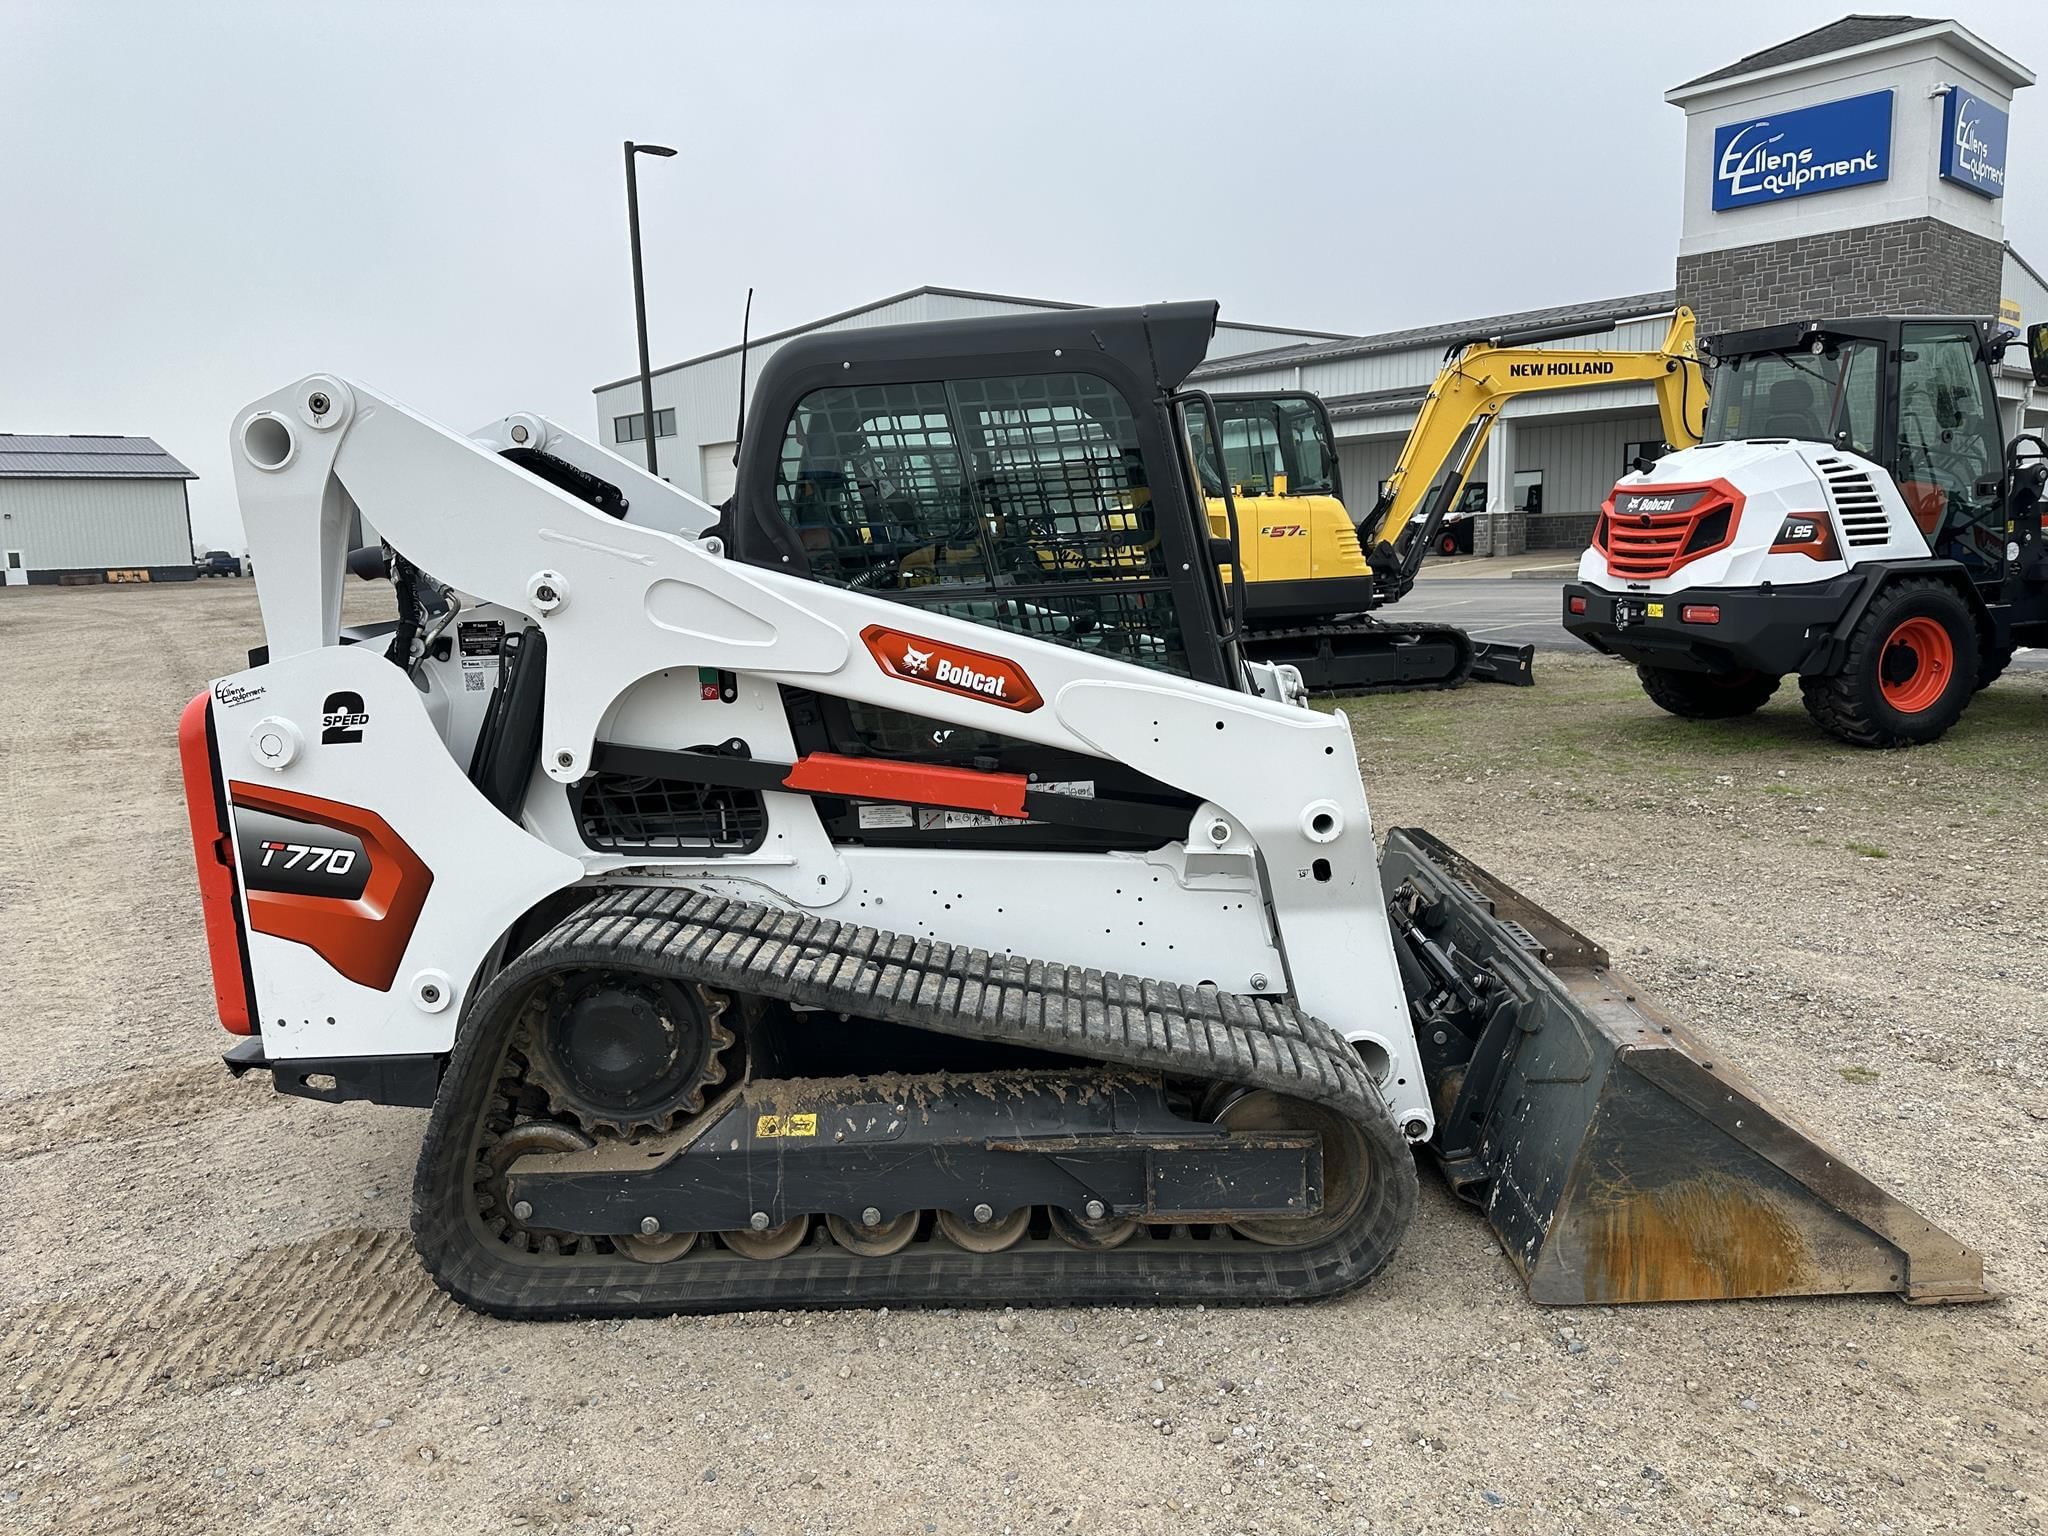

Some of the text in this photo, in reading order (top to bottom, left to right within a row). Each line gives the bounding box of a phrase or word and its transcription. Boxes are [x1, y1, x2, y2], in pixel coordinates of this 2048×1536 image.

[1719, 122, 1813, 180] Ellens
[1957, 99, 1988, 158] Ellens
[1731, 134, 1878, 195] Equipment
[1960, 120, 2004, 186] Equipment
[1510, 362, 1613, 376] NEW HOLLAND
[1639, 498, 1675, 511] Bobcat
[936, 659, 1006, 697] Bobcat
[321, 691, 365, 745] 2
[322, 714, 370, 727] SPEED
[261, 841, 356, 875] T770
